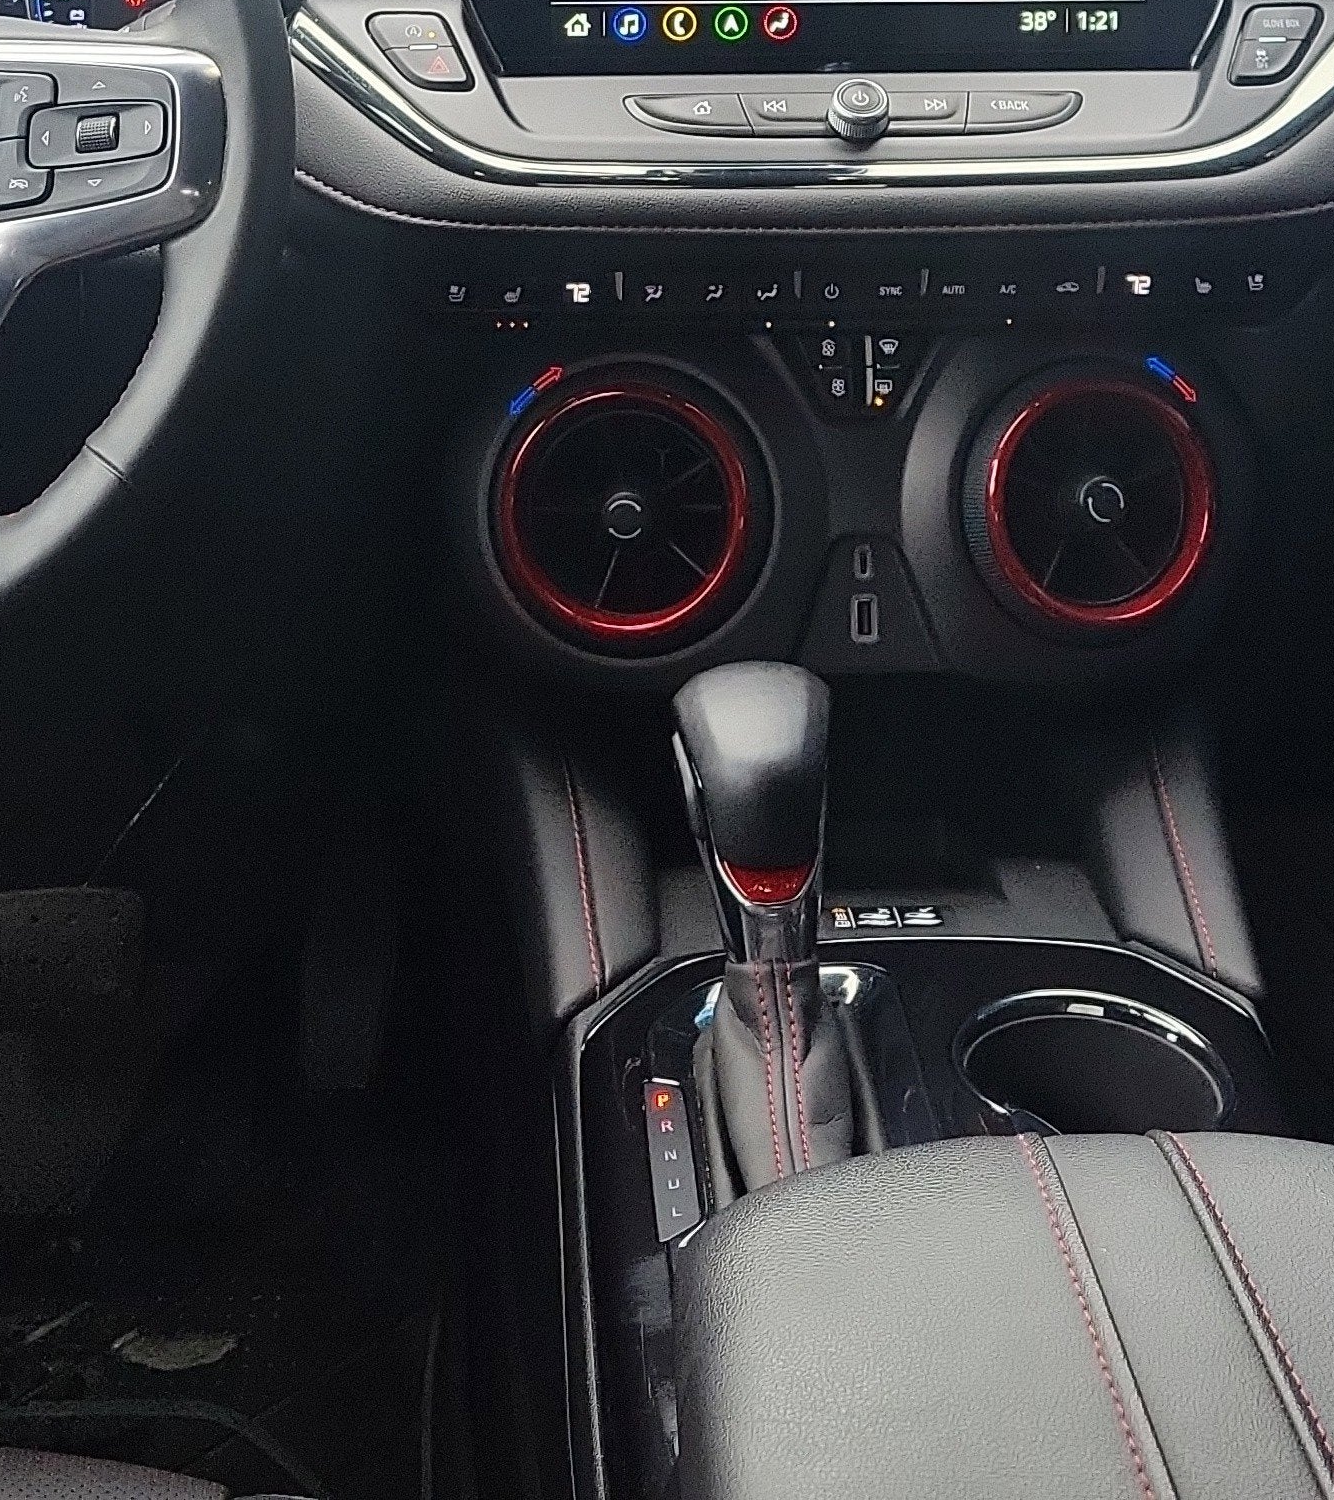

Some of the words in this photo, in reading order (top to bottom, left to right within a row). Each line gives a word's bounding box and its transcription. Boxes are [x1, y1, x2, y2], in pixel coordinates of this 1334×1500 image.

[1020, 10, 1057, 31] 38°
[1076, 10, 1118, 31] 1:21
[998, 101, 1030, 111] BACK
[942, 285, 966, 296] AUTO
[999, 284, 1017, 296] A/C
[1125, 274, 1152, 295] 72
[566, 283, 591, 303] 72
[879, 286, 903, 297] SYNC
[657, 1093, 669, 1107] P
[660, 1120, 674, 1133] R
[664, 1149, 678, 1161] N
[671, 1206, 683, 1218] L
